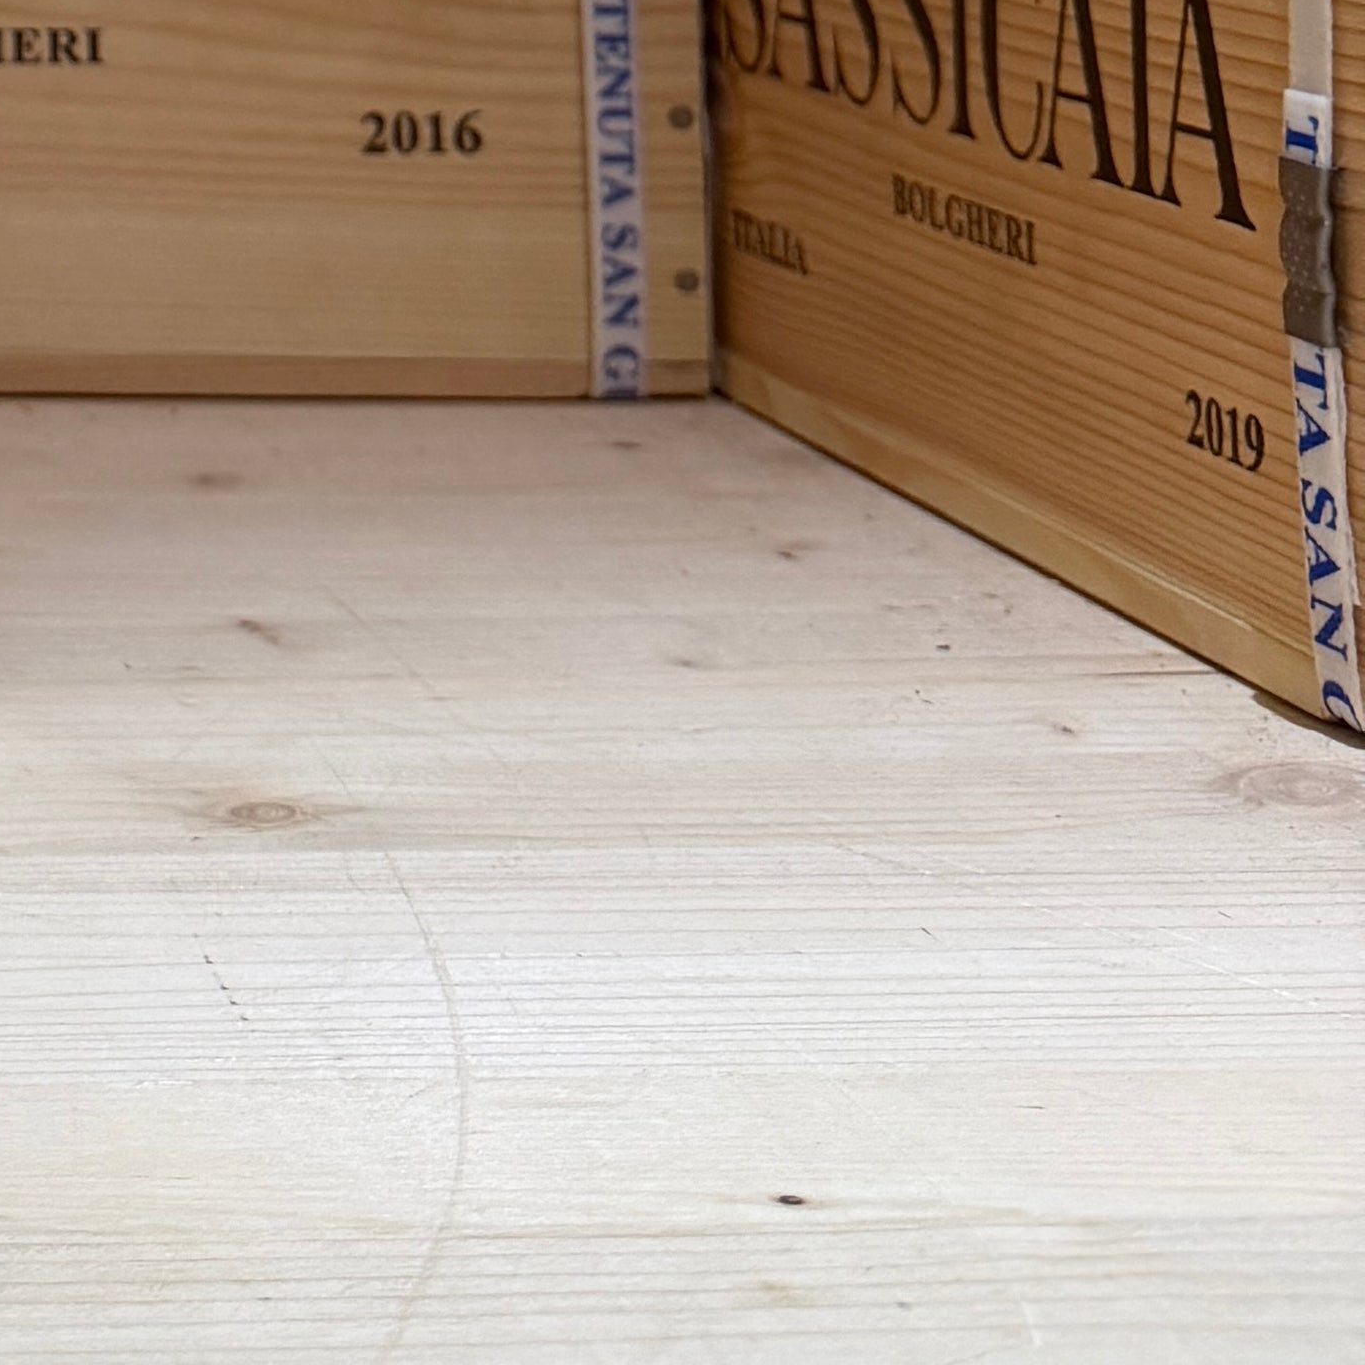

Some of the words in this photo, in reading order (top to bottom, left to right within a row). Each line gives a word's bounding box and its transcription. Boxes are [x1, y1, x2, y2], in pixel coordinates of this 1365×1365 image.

[361, 109, 483, 156] 2016
[731, 208, 808, 276] ITALIA
[891, 173, 1037, 267] BOLGHERI
[600, 222, 640, 328] SAN
[1186, 391, 1265, 472] 2019
[1294, 351, 1331, 457] TA
[1300, 478, 1349, 662] SAN
